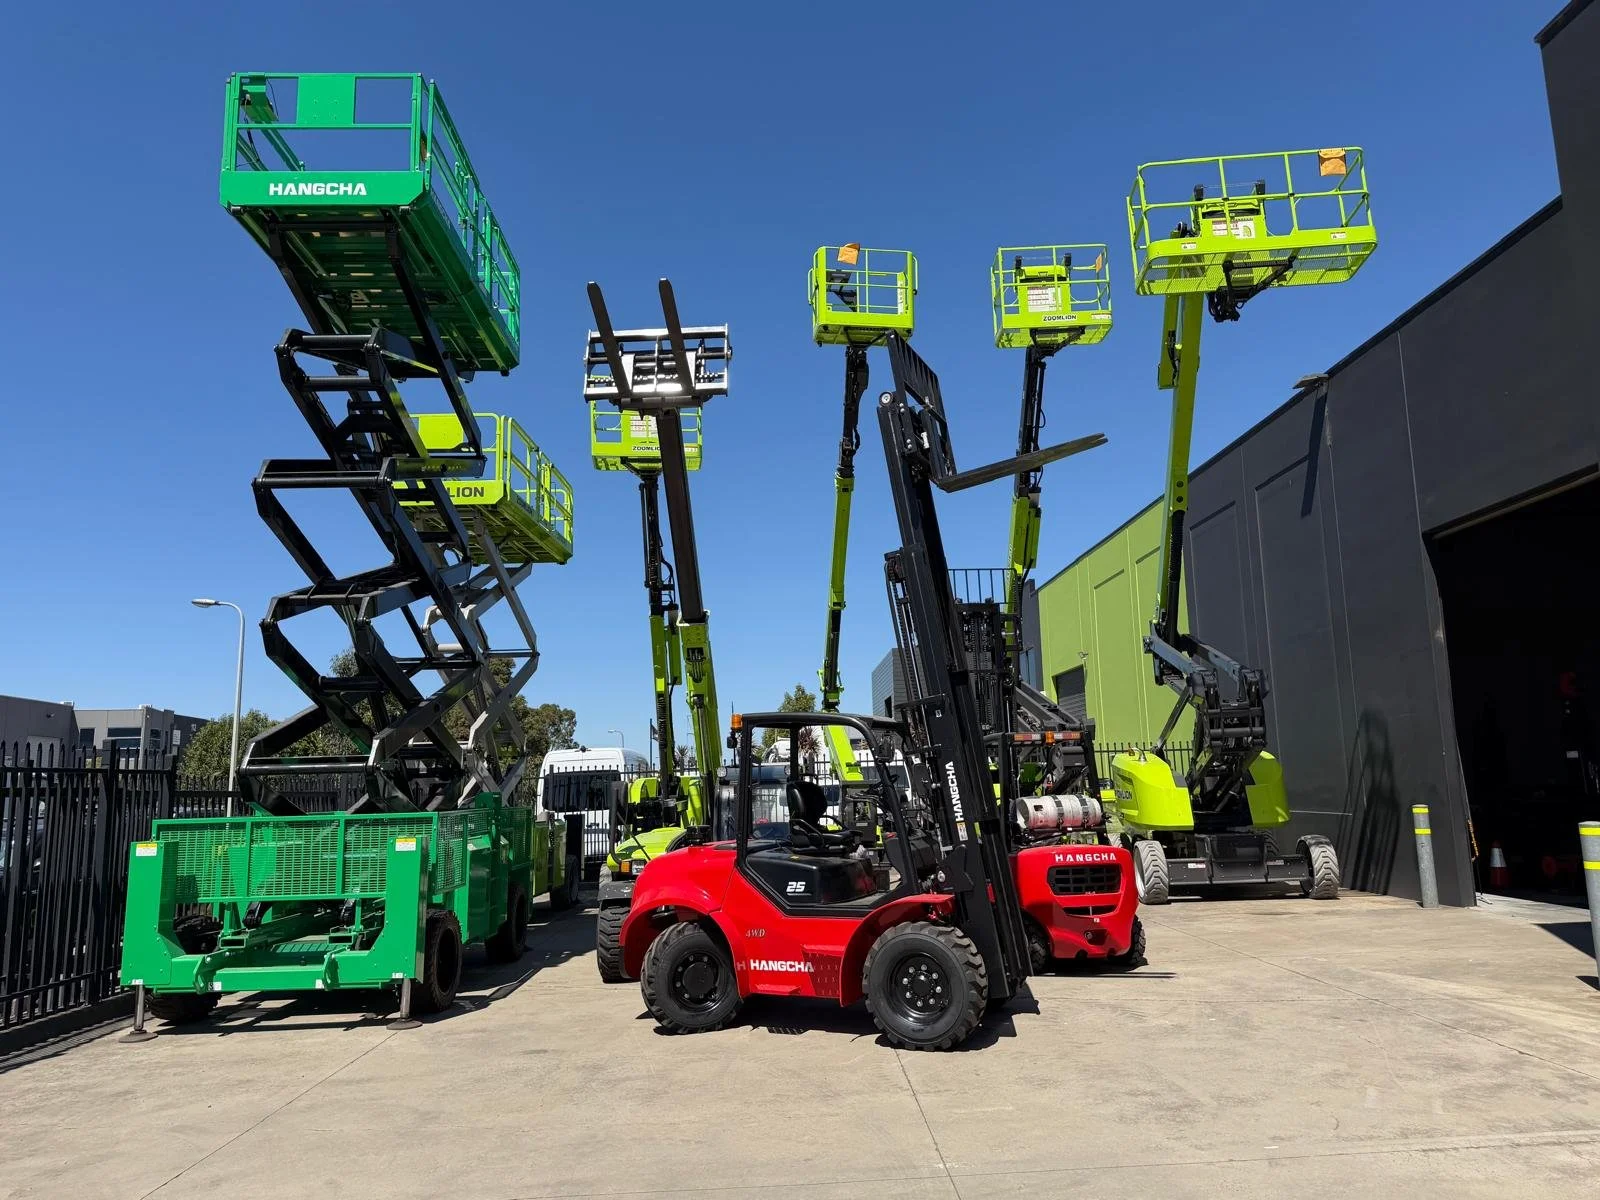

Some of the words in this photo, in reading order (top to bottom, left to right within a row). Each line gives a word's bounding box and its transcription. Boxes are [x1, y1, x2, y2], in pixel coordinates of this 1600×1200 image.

[264, 183, 368, 196] HANGCHA
[945, 761, 965, 822] HANGCHA
[1055, 852, 1117, 862] HANGCHA
[786, 881, 806, 893] 25
[745, 928, 766, 938] 4WD
[749, 959, 815, 973] HANGCHA
